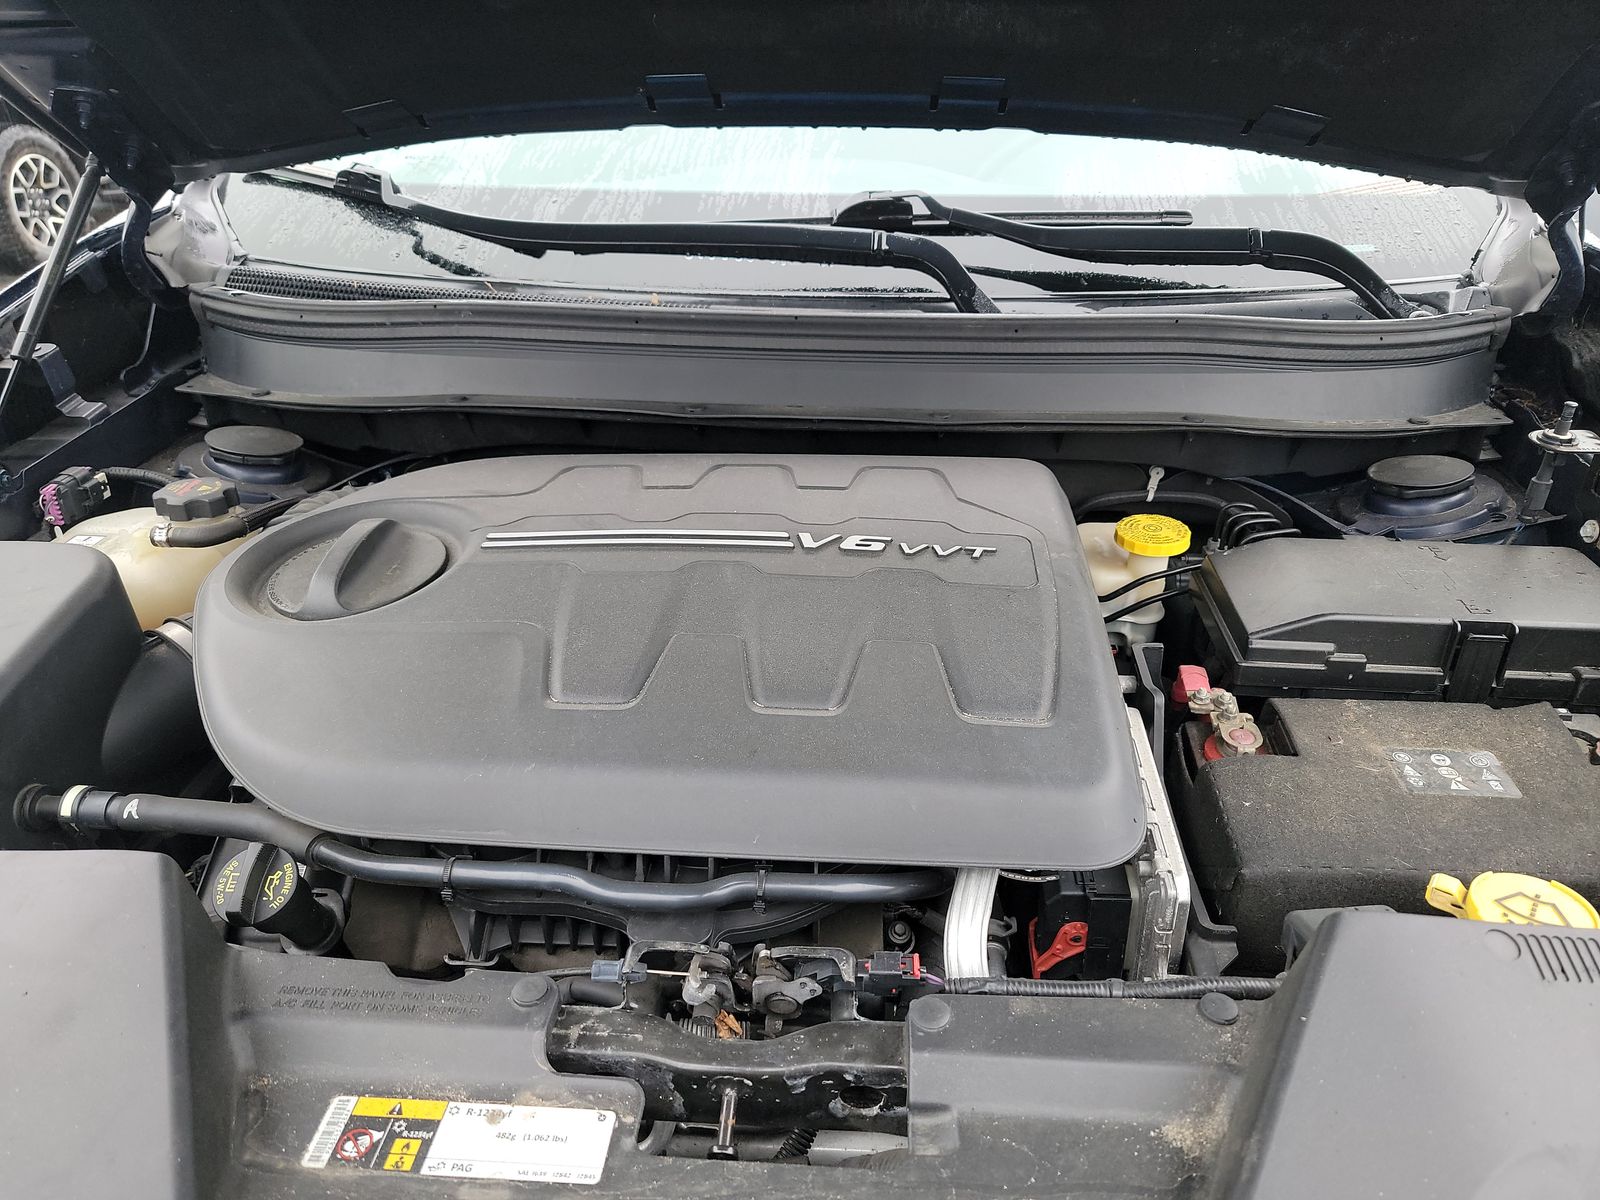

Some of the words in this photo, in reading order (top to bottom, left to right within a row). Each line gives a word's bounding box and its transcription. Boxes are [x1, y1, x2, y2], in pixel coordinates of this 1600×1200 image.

[797, 532, 894, 552] V6
[899, 542, 997, 560] VVT
[223, 860, 239, 876] SAE
[281, 862, 294, 895] ENGINE
[216, 877, 227, 905] 5W-20
[269, 896, 285, 910] OIL
[279, 985, 330, 997] REMOVE
[331, 987, 359, 998] THIS
[360, 989, 396, 1000] PANEL
[271, 997, 298, 1009] A/C
[301, 999, 326, 1010] FILL
[329, 1000, 363, 1012] PORT
[495, 1132, 517, 1142] 482g
[523, 1133, 550, 1142] (1.062
[551, 1135, 569, 1144] lbs)
[451, 1163, 473, 1173] PAG
